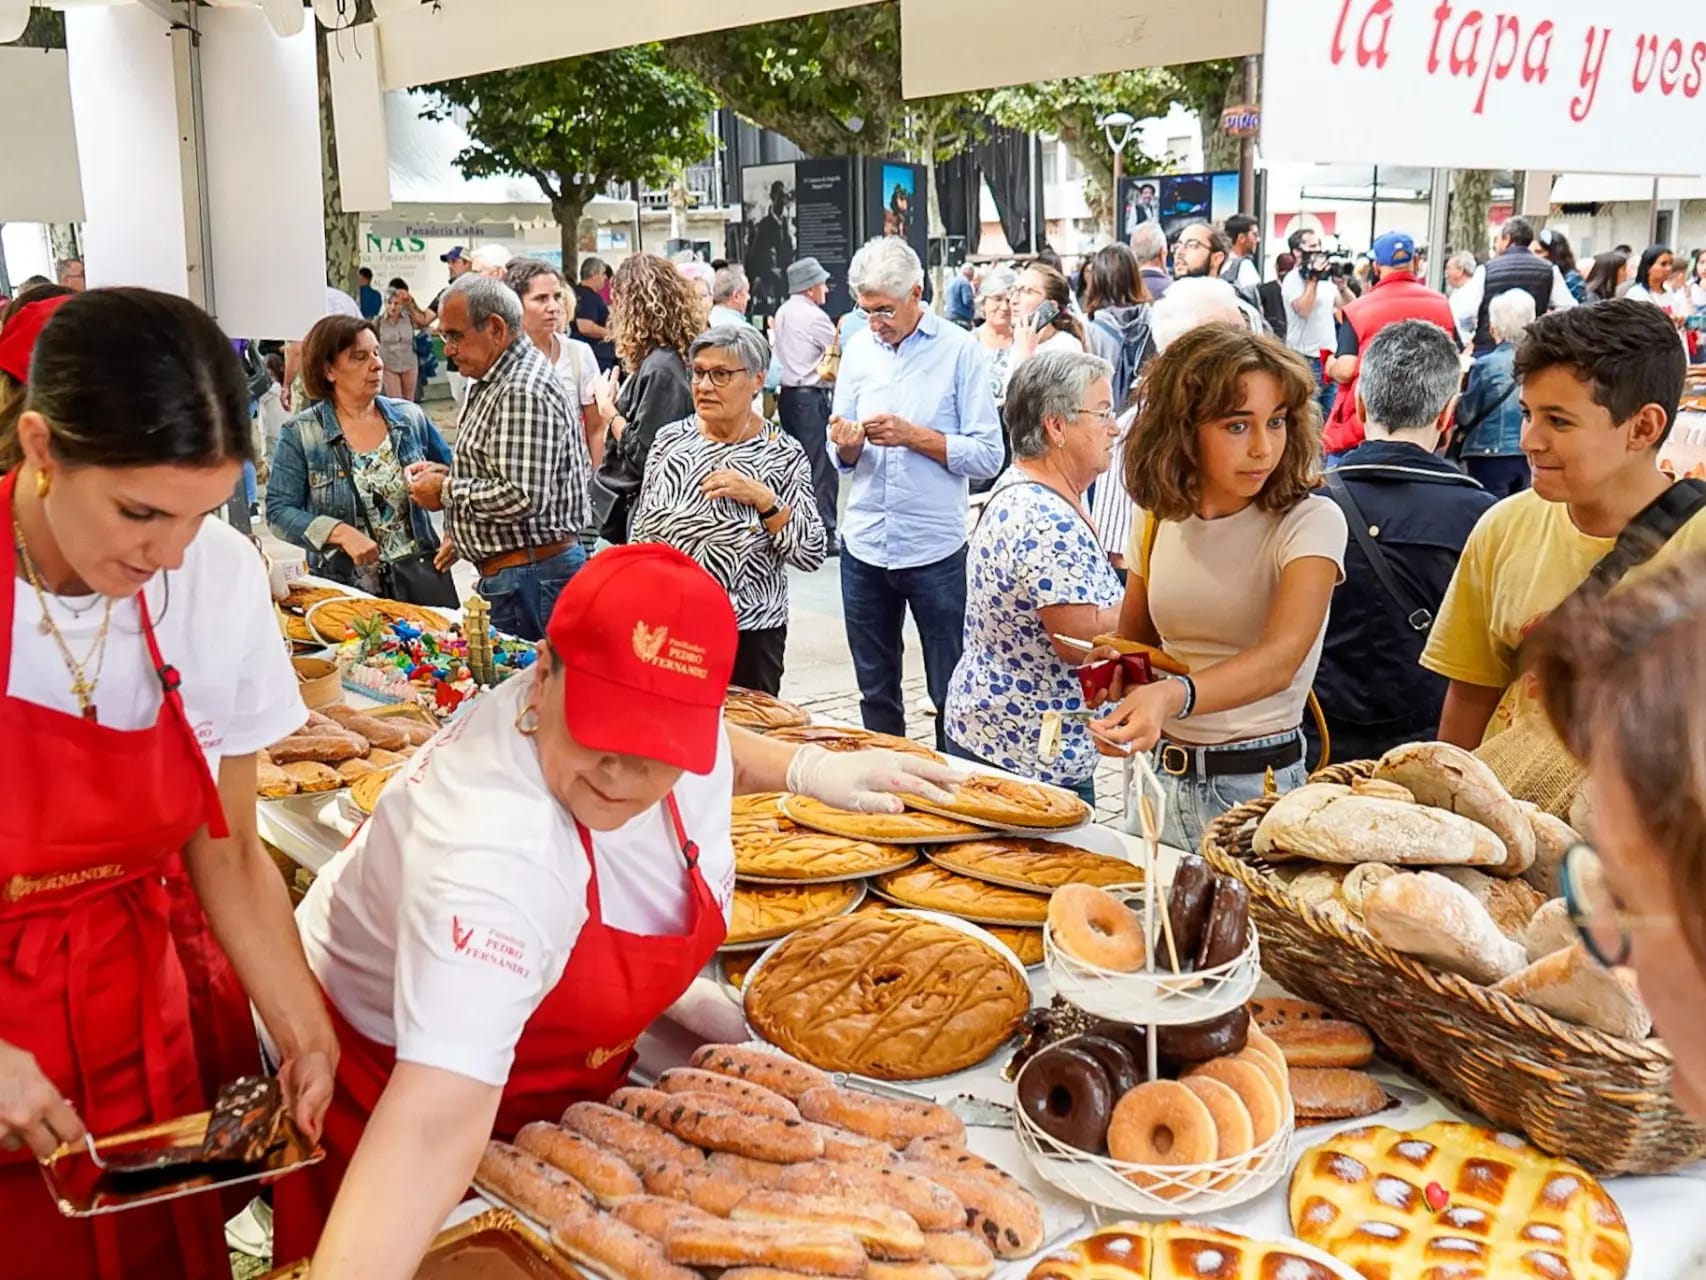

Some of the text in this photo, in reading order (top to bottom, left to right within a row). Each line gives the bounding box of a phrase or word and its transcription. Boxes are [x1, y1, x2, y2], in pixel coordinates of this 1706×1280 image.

[1329, 0, 1706, 122] la tapa y ves
[669, 646, 703, 664] PEDRO
[485, 938, 523, 960] PEDRO
